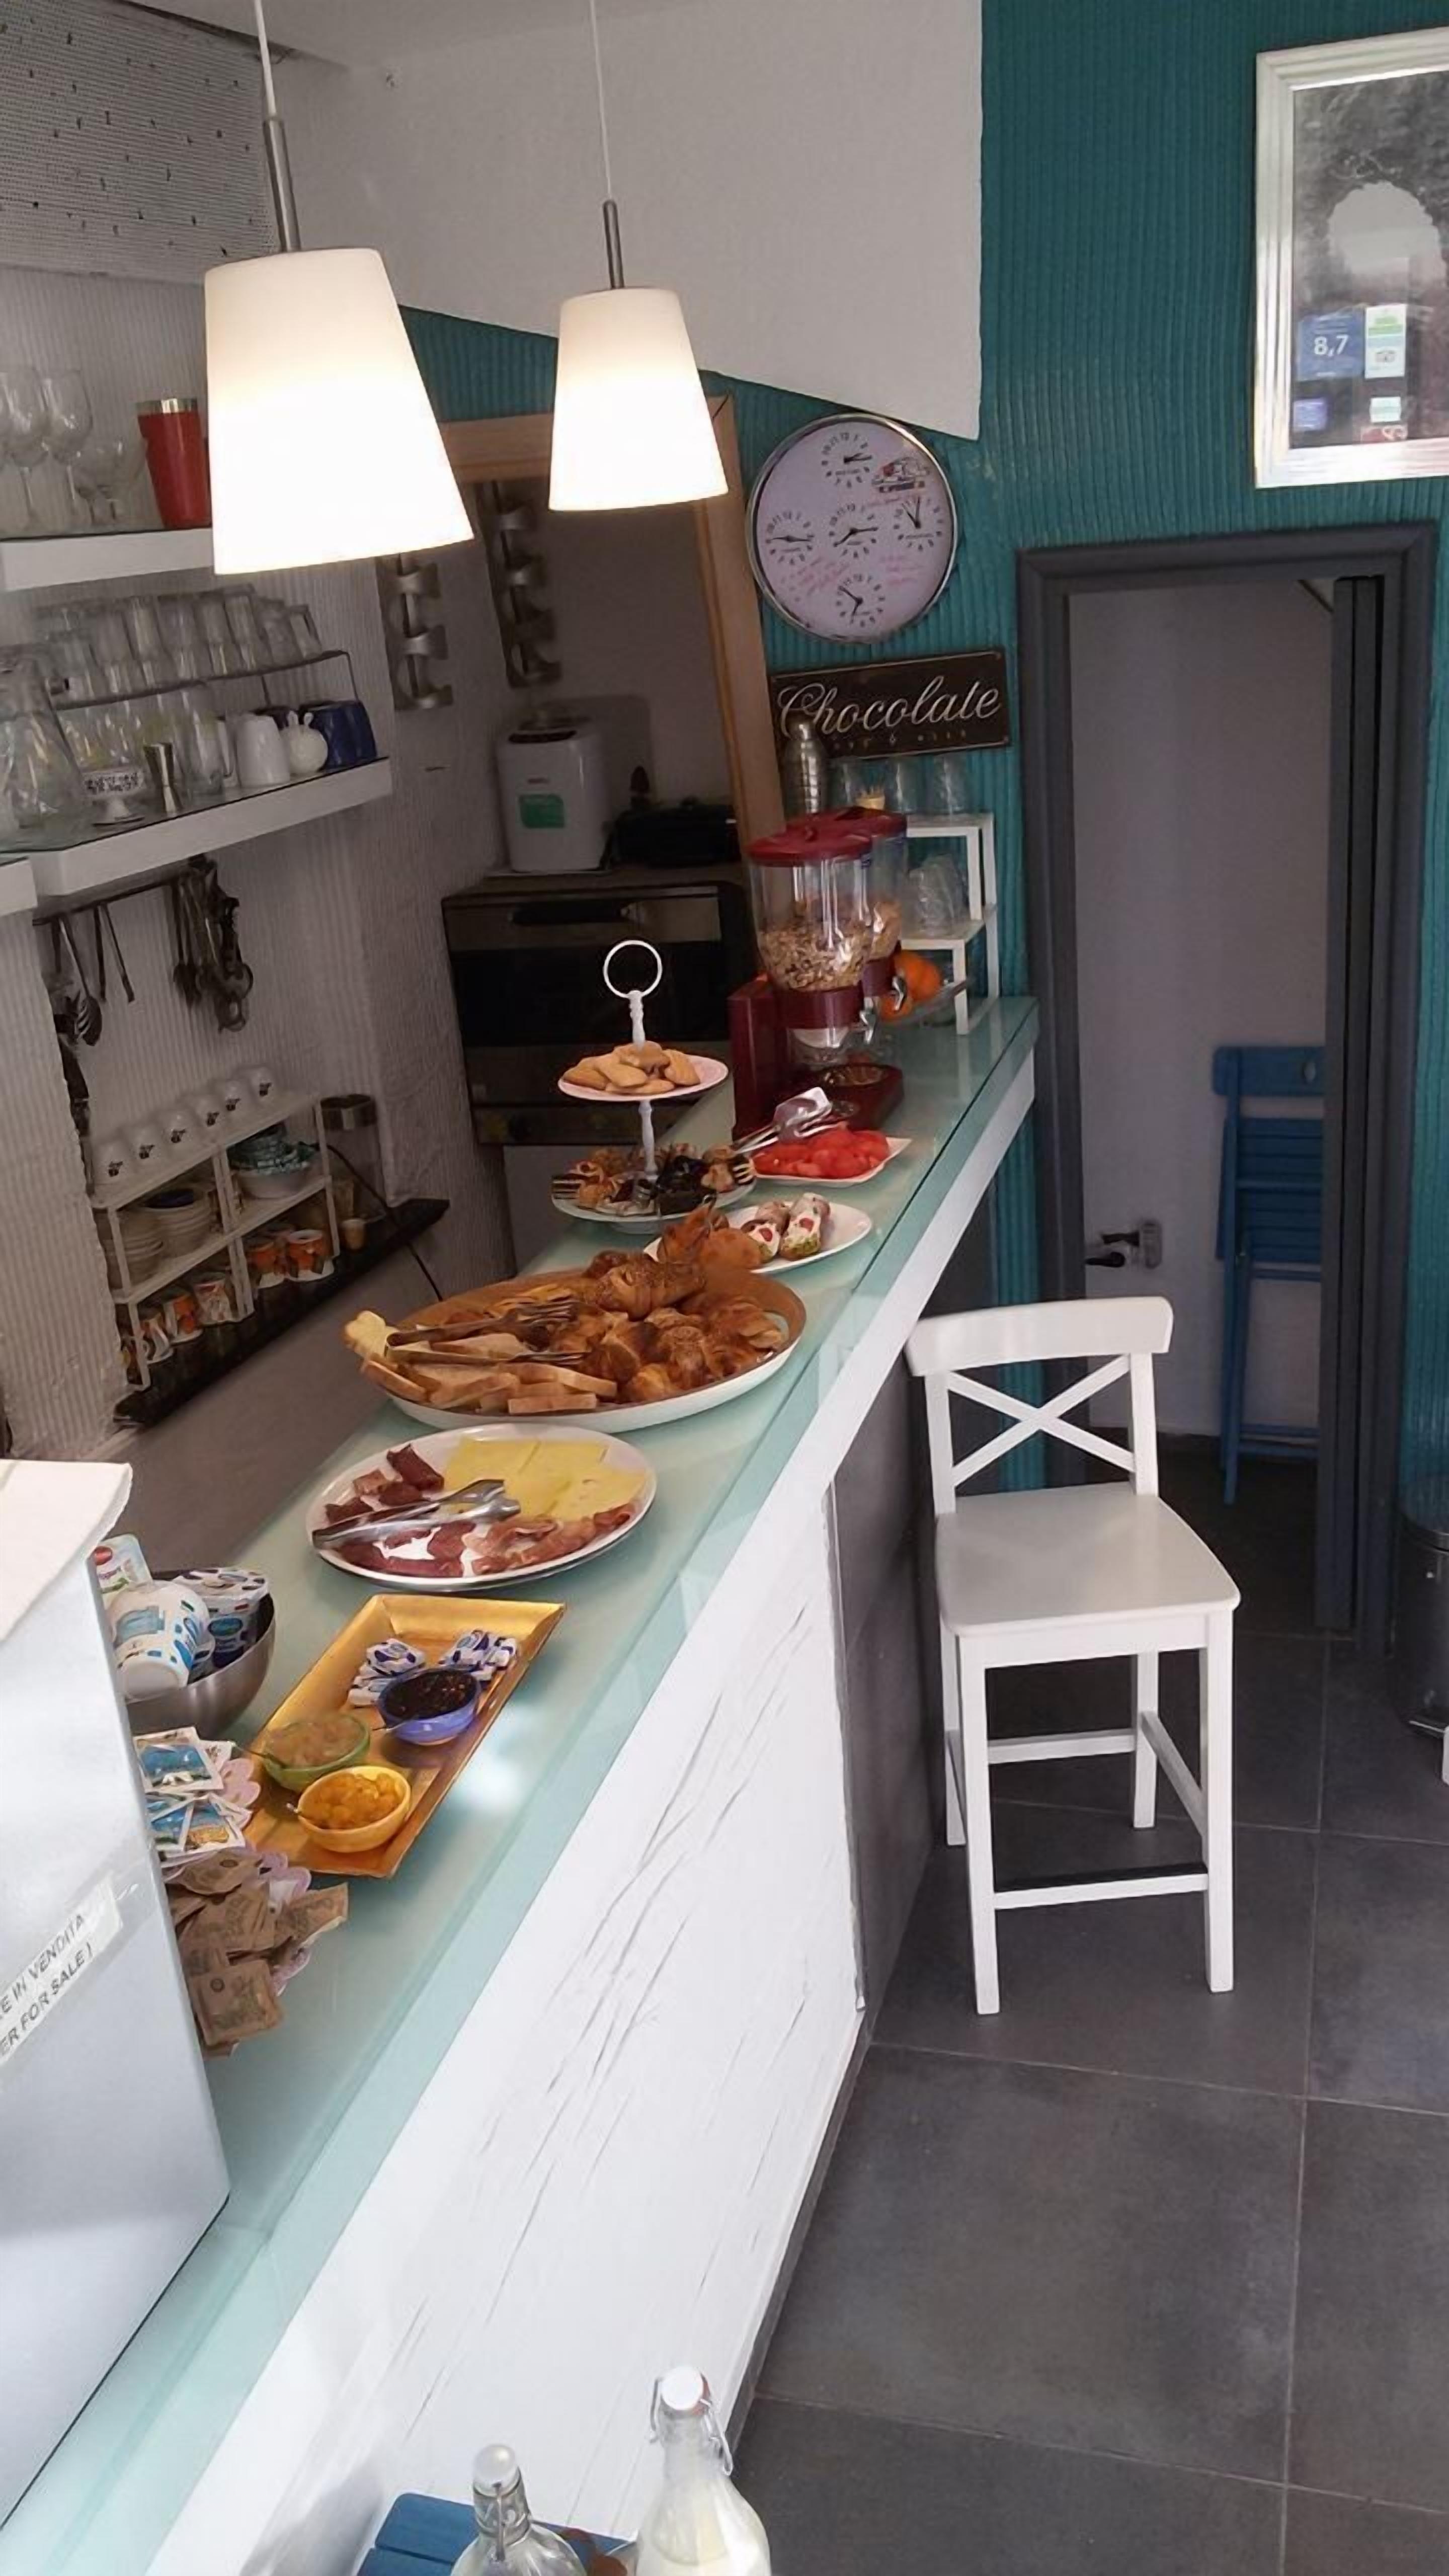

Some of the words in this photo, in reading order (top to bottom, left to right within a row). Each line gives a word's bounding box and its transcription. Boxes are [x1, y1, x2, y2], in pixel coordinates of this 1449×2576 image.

[1314, 335, 1349, 357] 8,7
[778, 675, 1001, 739] Chocolate
[28, 1914, 85, 1979] VENDITA
[21, 1991, 49, 2031] FOR
